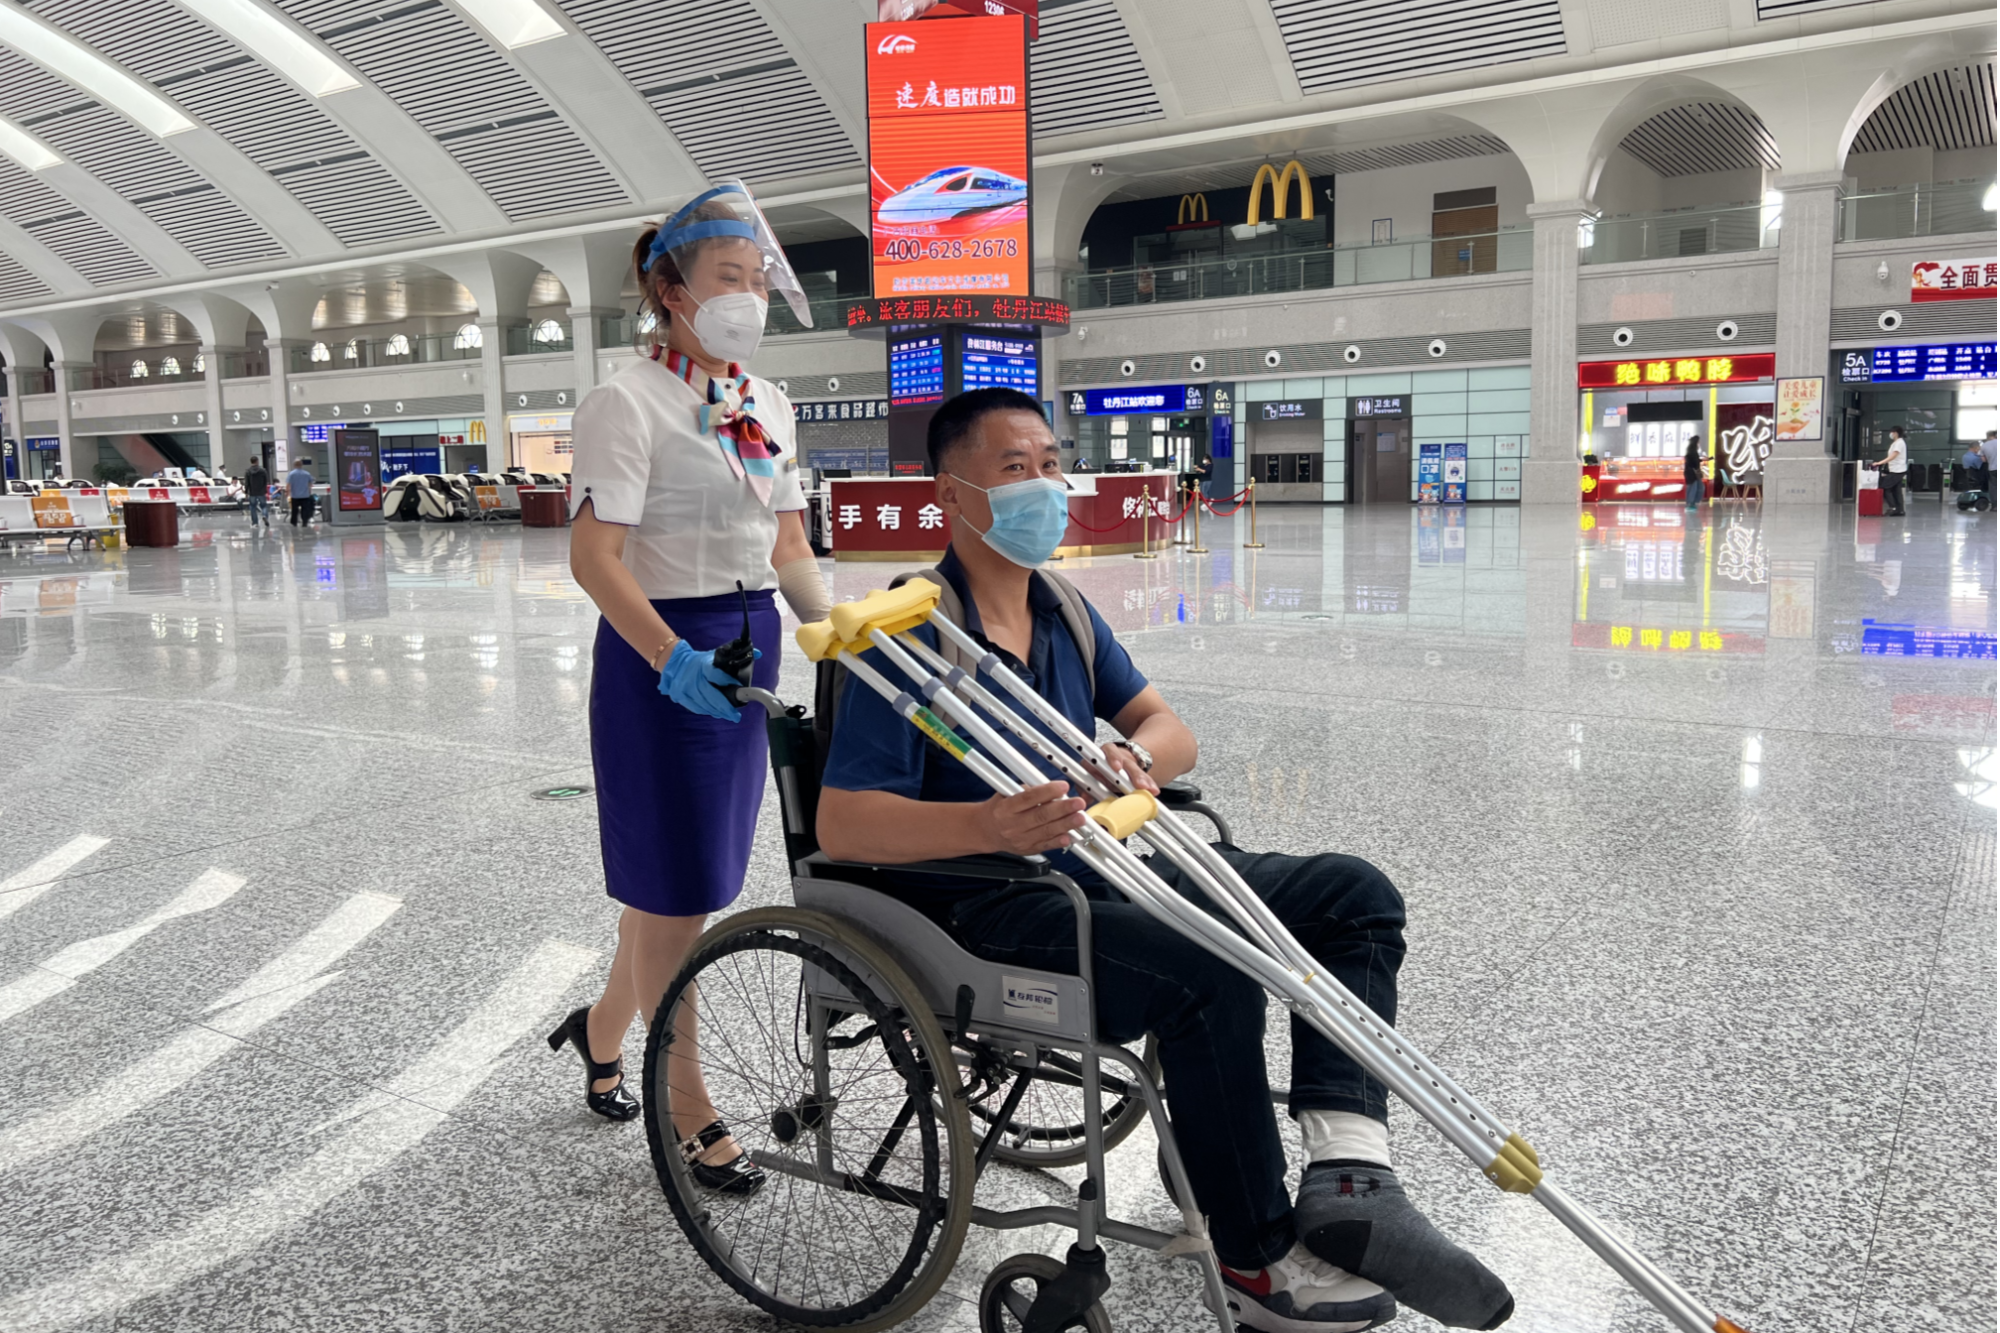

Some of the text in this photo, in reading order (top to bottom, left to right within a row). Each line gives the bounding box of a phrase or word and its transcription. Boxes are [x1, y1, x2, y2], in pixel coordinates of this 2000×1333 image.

[896, 80, 1016, 109] 速度造就成功
[884, 238, 1018, 261] 400-628-2678
[1940, 263, 1997, 290] 全面贯
[1845, 353, 1867, 367] 5A
[1616, 359, 1733, 385] 绝味鸭脖
[1842, 367, 1870, 377] 检票口
[1072, 392, 1084, 404] 7A
[1187, 387, 1201, 398] 6A
[1215, 389, 1229, 401] 6A
[1103, 395, 1165, 409] 牡丹江站欢迎您
[1279, 403, 1302, 412] 饮用水
[1374, 398, 1400, 408] 卫生间
[801, 401, 889, 420] 万客来食品超市
[838, 503, 944, 530] 手有余
